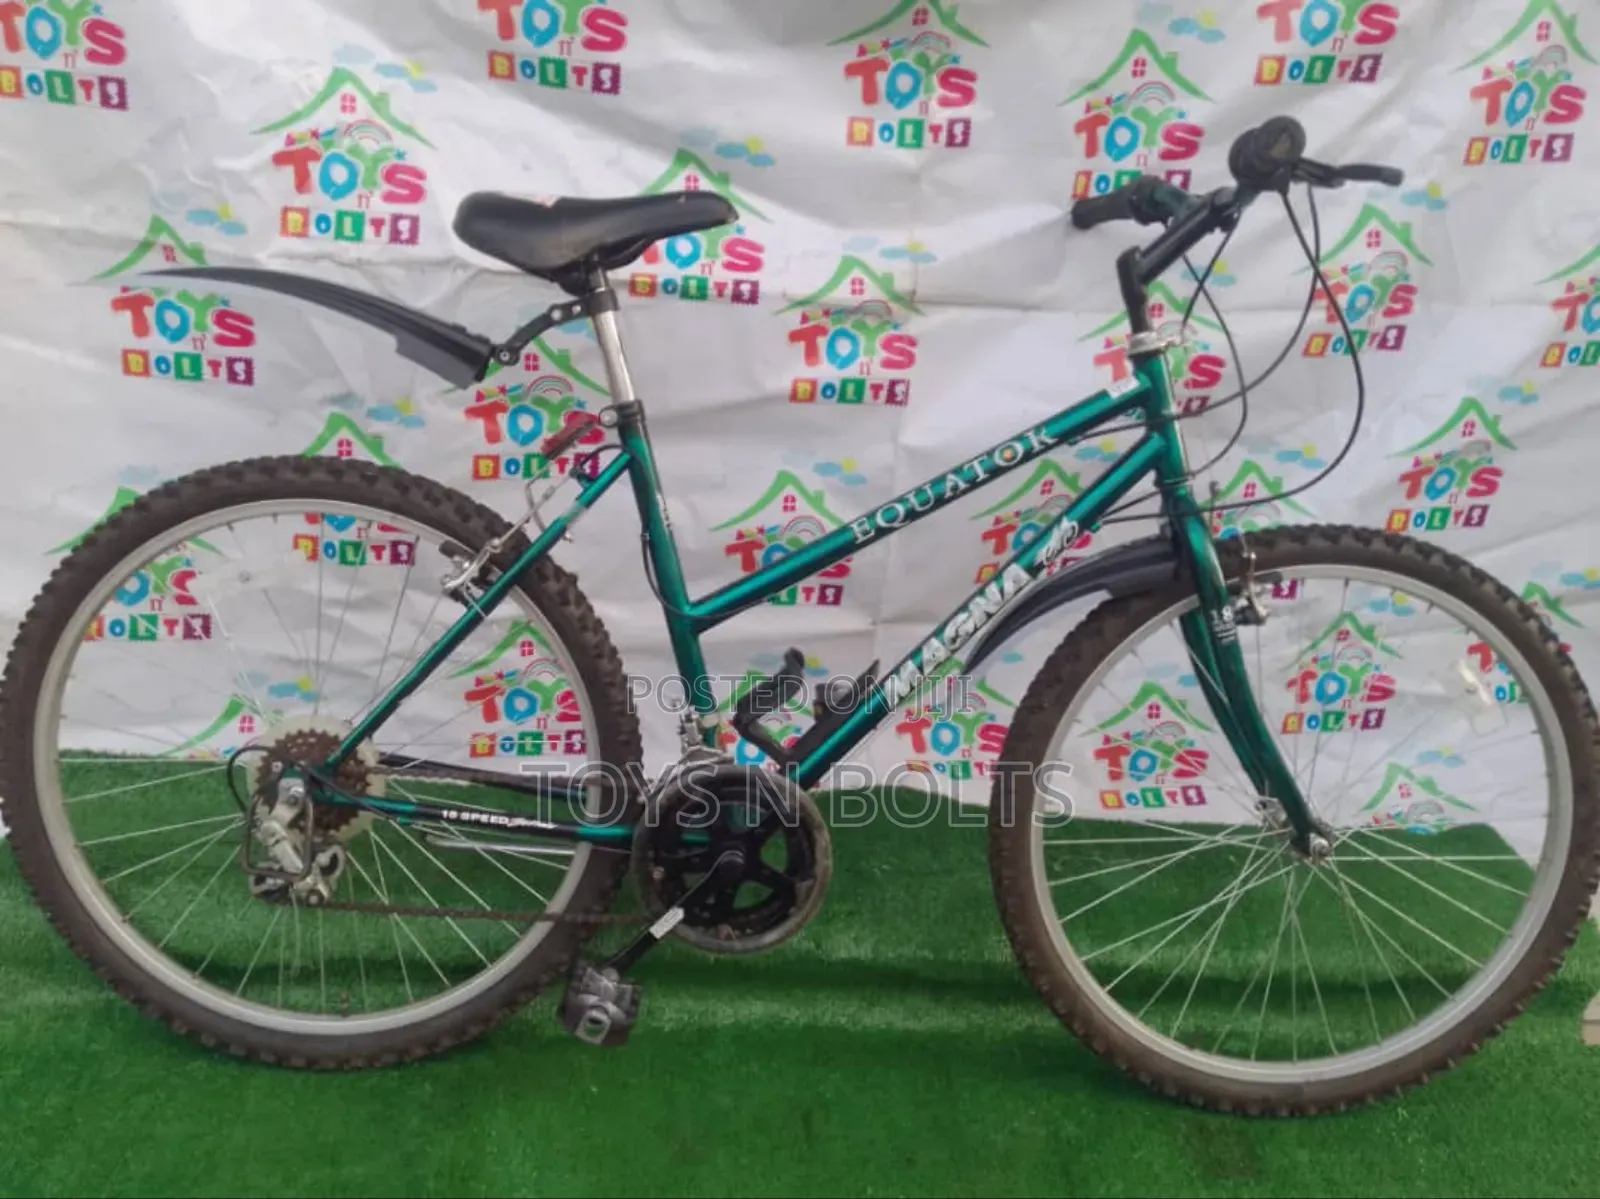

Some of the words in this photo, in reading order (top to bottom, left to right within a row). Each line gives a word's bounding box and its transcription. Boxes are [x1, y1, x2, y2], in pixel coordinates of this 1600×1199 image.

[0, 0, 127, 66] TOYS
[477, 0, 628, 52] TOYS
[1257, 0, 1400, 47] TOYS
[487, 50, 621, 95] BOLTS
[844, 53, 978, 110] TOYS
[1255, 54, 1383, 86] BOLTS
[1470, 71, 1587, 128] TOYS
[847, 117, 971, 149] BOLTS
[1074, 106, 1205, 162] TOYS
[1463, 133, 1574, 166] BOLTS
[272, 144, 428, 204] TOYS
[280, 206, 420, 245] BOLTS
[630, 273, 759, 305] BOLTS
[1314, 274, 1418, 324] TOYS
[110, 290, 256, 348] TOYS
[121, 349, 254, 386] BOLTS
[788, 320, 918, 371] TOYS
[1093, 346, 1226, 389] TYS
[790, 378, 910, 405] BOLTS
[1399, 457, 1504, 501] TOYS
[1386, 505, 1490, 533] BOLTS
[115, 555, 198, 606] OYS
[885, 563, 1033, 706] MAGNA
[1287, 663, 1397, 706] TOYS
[470, 729, 586, 758] BOLTS
[896, 712, 1009, 756] TOYS
[1281, 708, 1385, 735] BOLTS
[1094, 739, 1209, 783] TOYS
[1100, 785, 1207, 811] BOLTS
